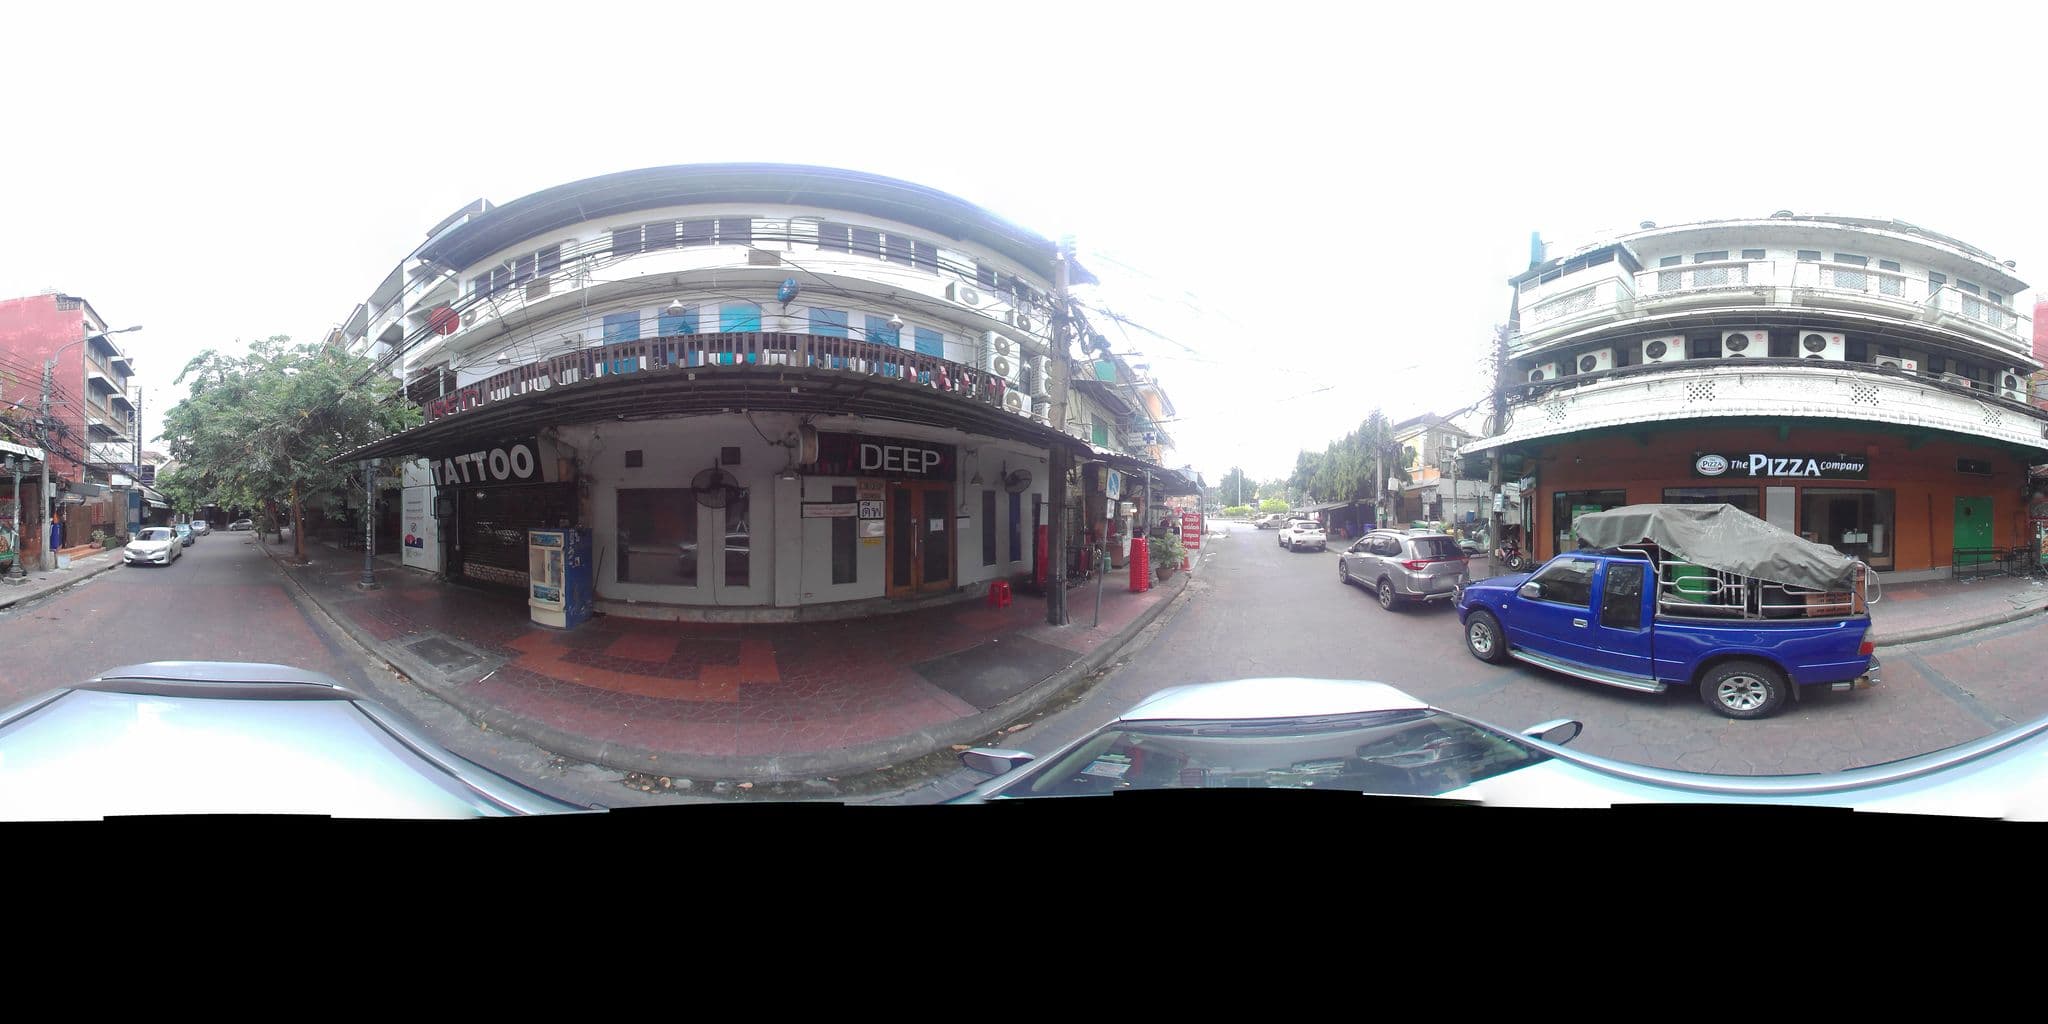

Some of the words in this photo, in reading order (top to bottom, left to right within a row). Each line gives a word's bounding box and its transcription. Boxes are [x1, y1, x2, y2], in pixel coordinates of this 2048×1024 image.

[431, 444, 534, 485] TATTOO
[861, 444, 940, 473] DEEP
[1731, 460, 1748, 468] The
[1749, 454, 1821, 476] PIZZA
